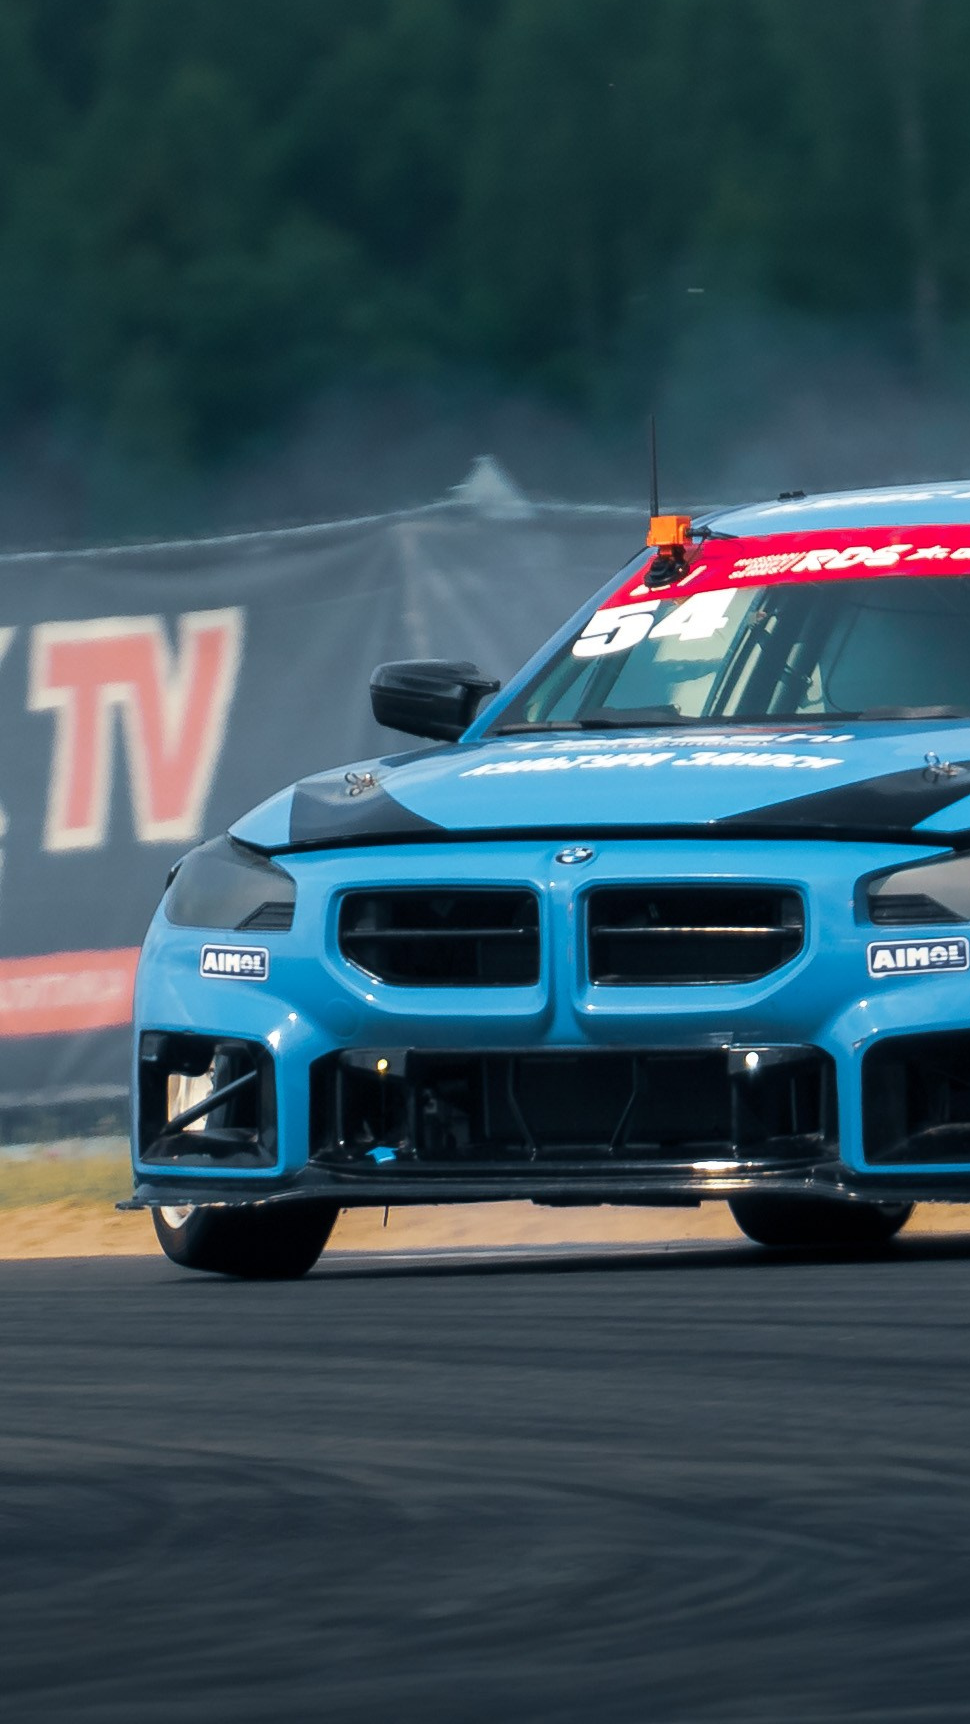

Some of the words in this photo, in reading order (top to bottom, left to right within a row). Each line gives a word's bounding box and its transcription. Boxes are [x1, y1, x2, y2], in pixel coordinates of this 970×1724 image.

[791, 544, 913, 573] RDS
[572, 587, 738, 657] 54
[203, 951, 265, 973] AIMOL
[872, 944, 965, 970] AIMOL
